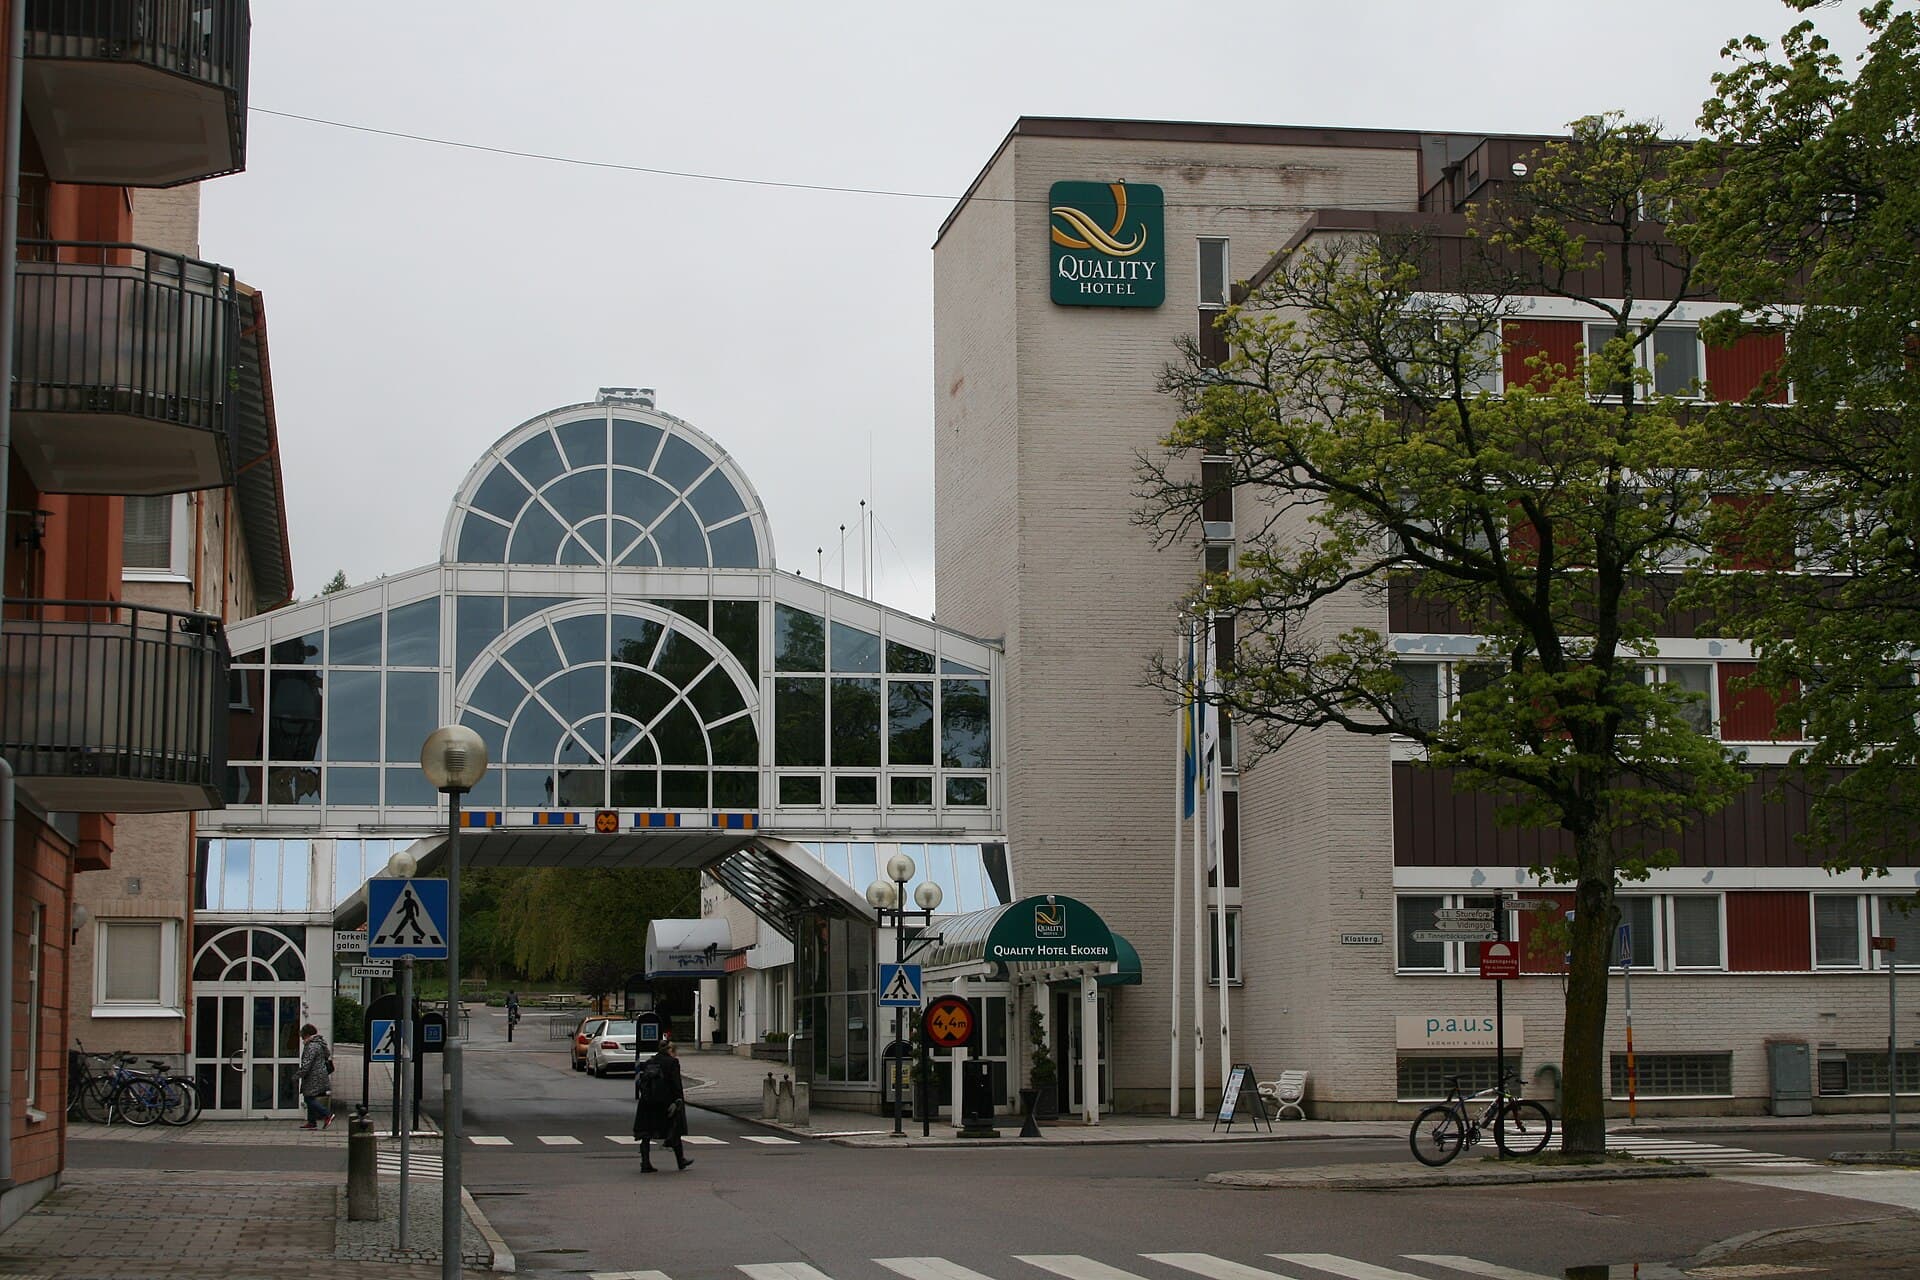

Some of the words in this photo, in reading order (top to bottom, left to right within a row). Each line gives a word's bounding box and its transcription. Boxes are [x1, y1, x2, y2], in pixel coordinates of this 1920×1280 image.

[1058, 254, 1156, 281] QUALITY
[1079, 282, 1135, 295] HOTEL
[336, 942, 360, 950] gatan
[993, 945, 1035, 957] QUALITY
[1037, 945, 1069, 955] HOTEL
[1071, 945, 1109, 955] EKOXEN
[1426, 1017, 1494, 1038] p.a.u.s
